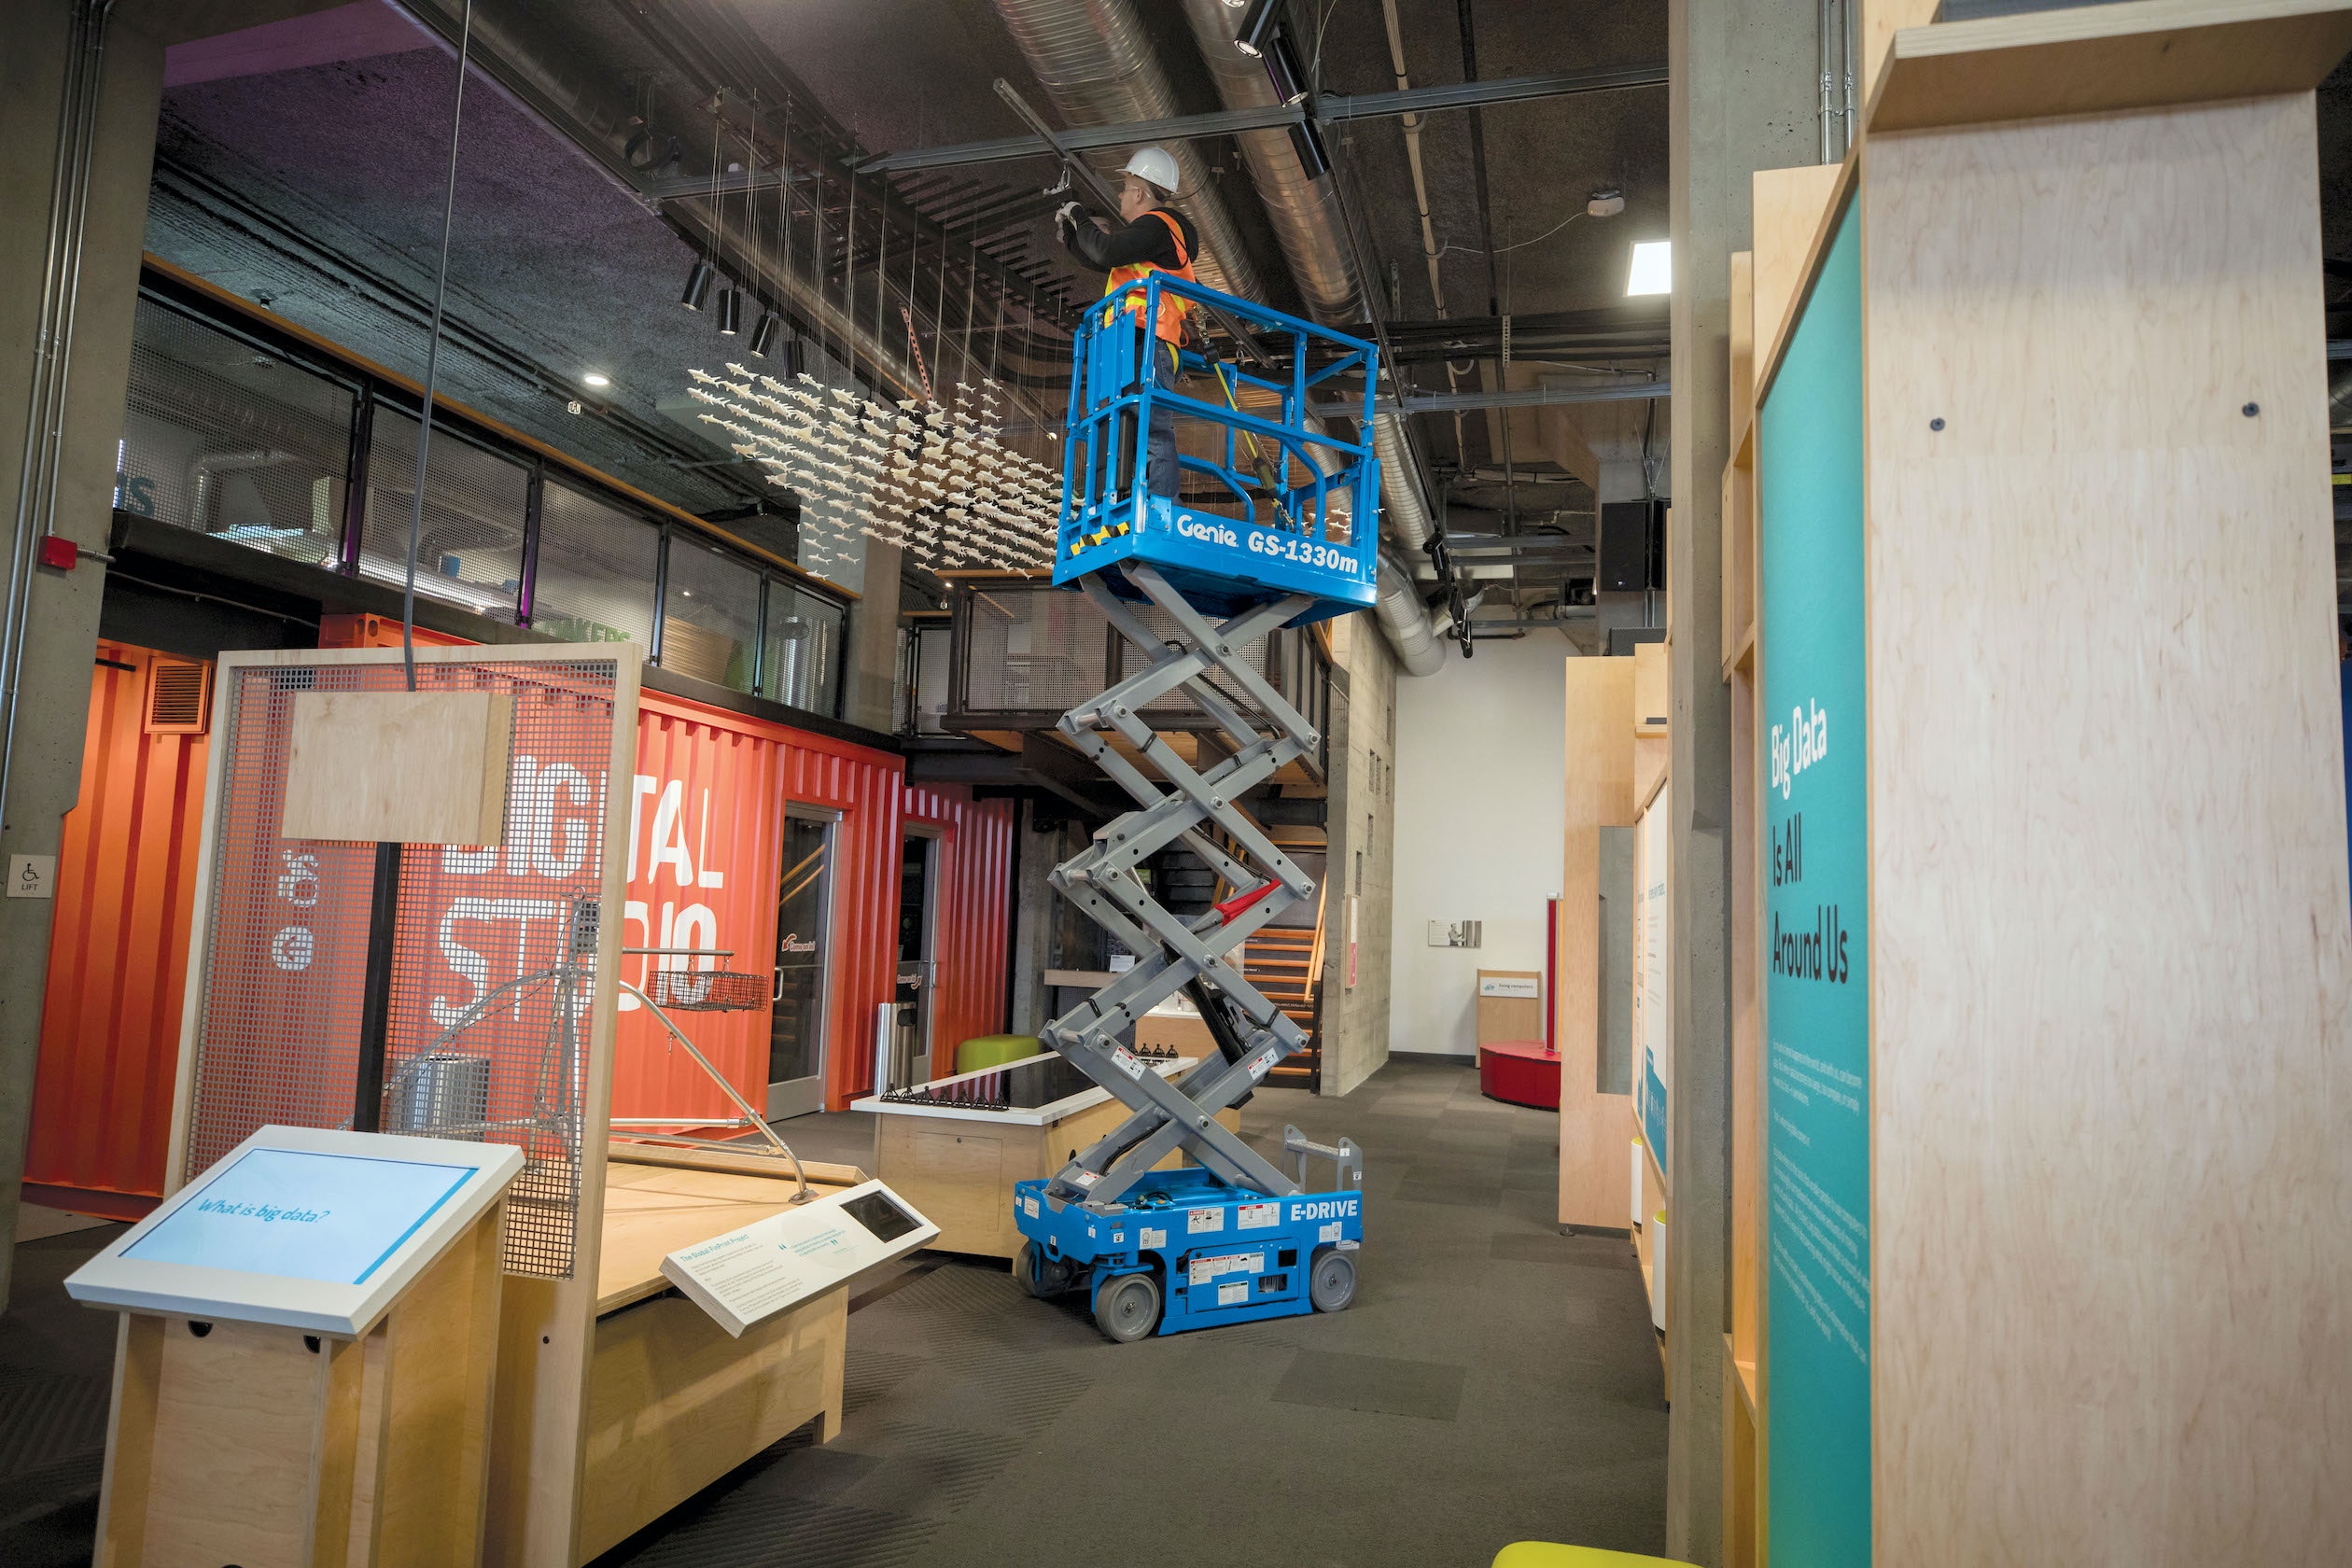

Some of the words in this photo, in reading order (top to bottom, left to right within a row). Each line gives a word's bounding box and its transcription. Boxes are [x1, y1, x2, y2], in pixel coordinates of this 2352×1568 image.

[1177, 514, 1238, 548] Genie
[1248, 531, 1358, 574] GS-1330m
[1772, 724, 1791, 800] Big
[1793, 697, 1827, 776] Data
[1773, 825, 1783, 887] Is
[1785, 811, 1802, 885] All
[21, 883, 38, 891] LIFT
[1773, 903, 1822, 982] Around
[1827, 903, 1849, 985] Us
[198, 1197, 243, 1214] What
[239, 1203, 257, 1216] is
[255, 1204, 283, 1223] big
[281, 1208, 330, 1224] data?
[1291, 1199, 1358, 1222] E-DRIVE
